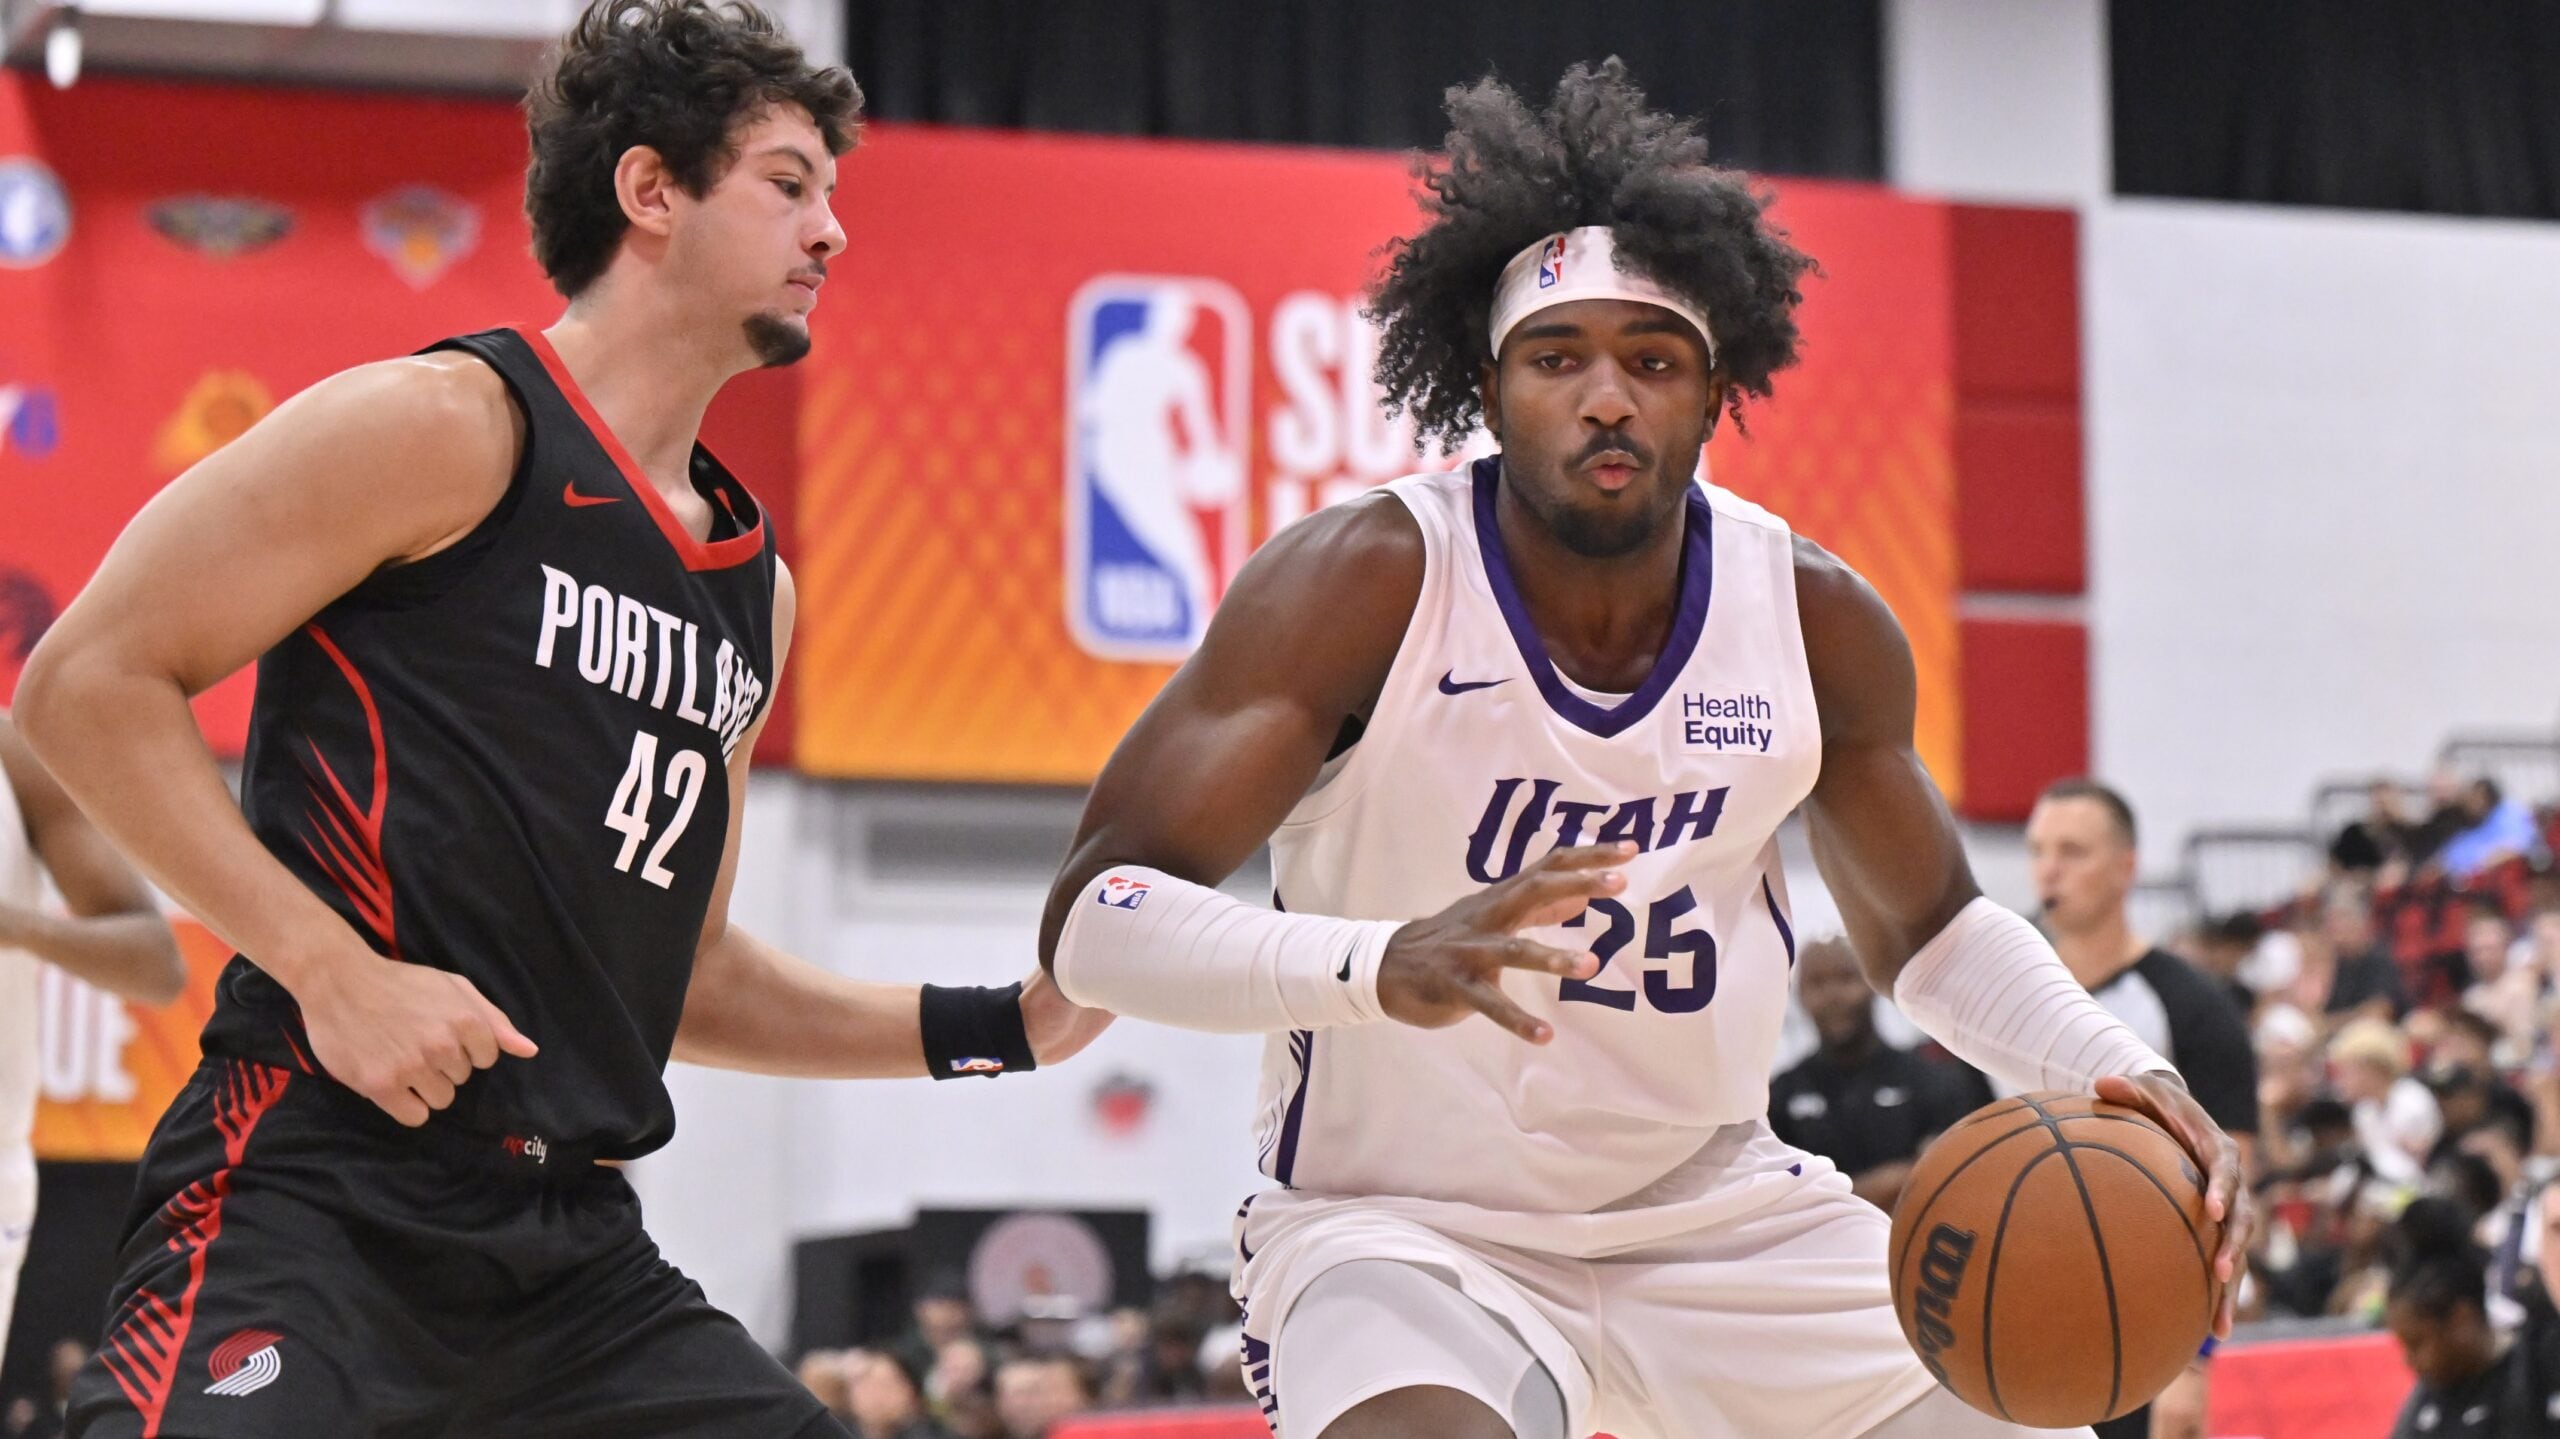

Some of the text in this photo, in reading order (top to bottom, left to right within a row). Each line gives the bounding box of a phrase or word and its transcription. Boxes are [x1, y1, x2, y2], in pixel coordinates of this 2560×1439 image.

[1683, 693, 1771, 719] Health
[1685, 721, 1773, 752] Equity
[604, 730, 706, 890] 42
[1466, 777, 1731, 885] UTAH
[1558, 884, 1717, 1014] 25
